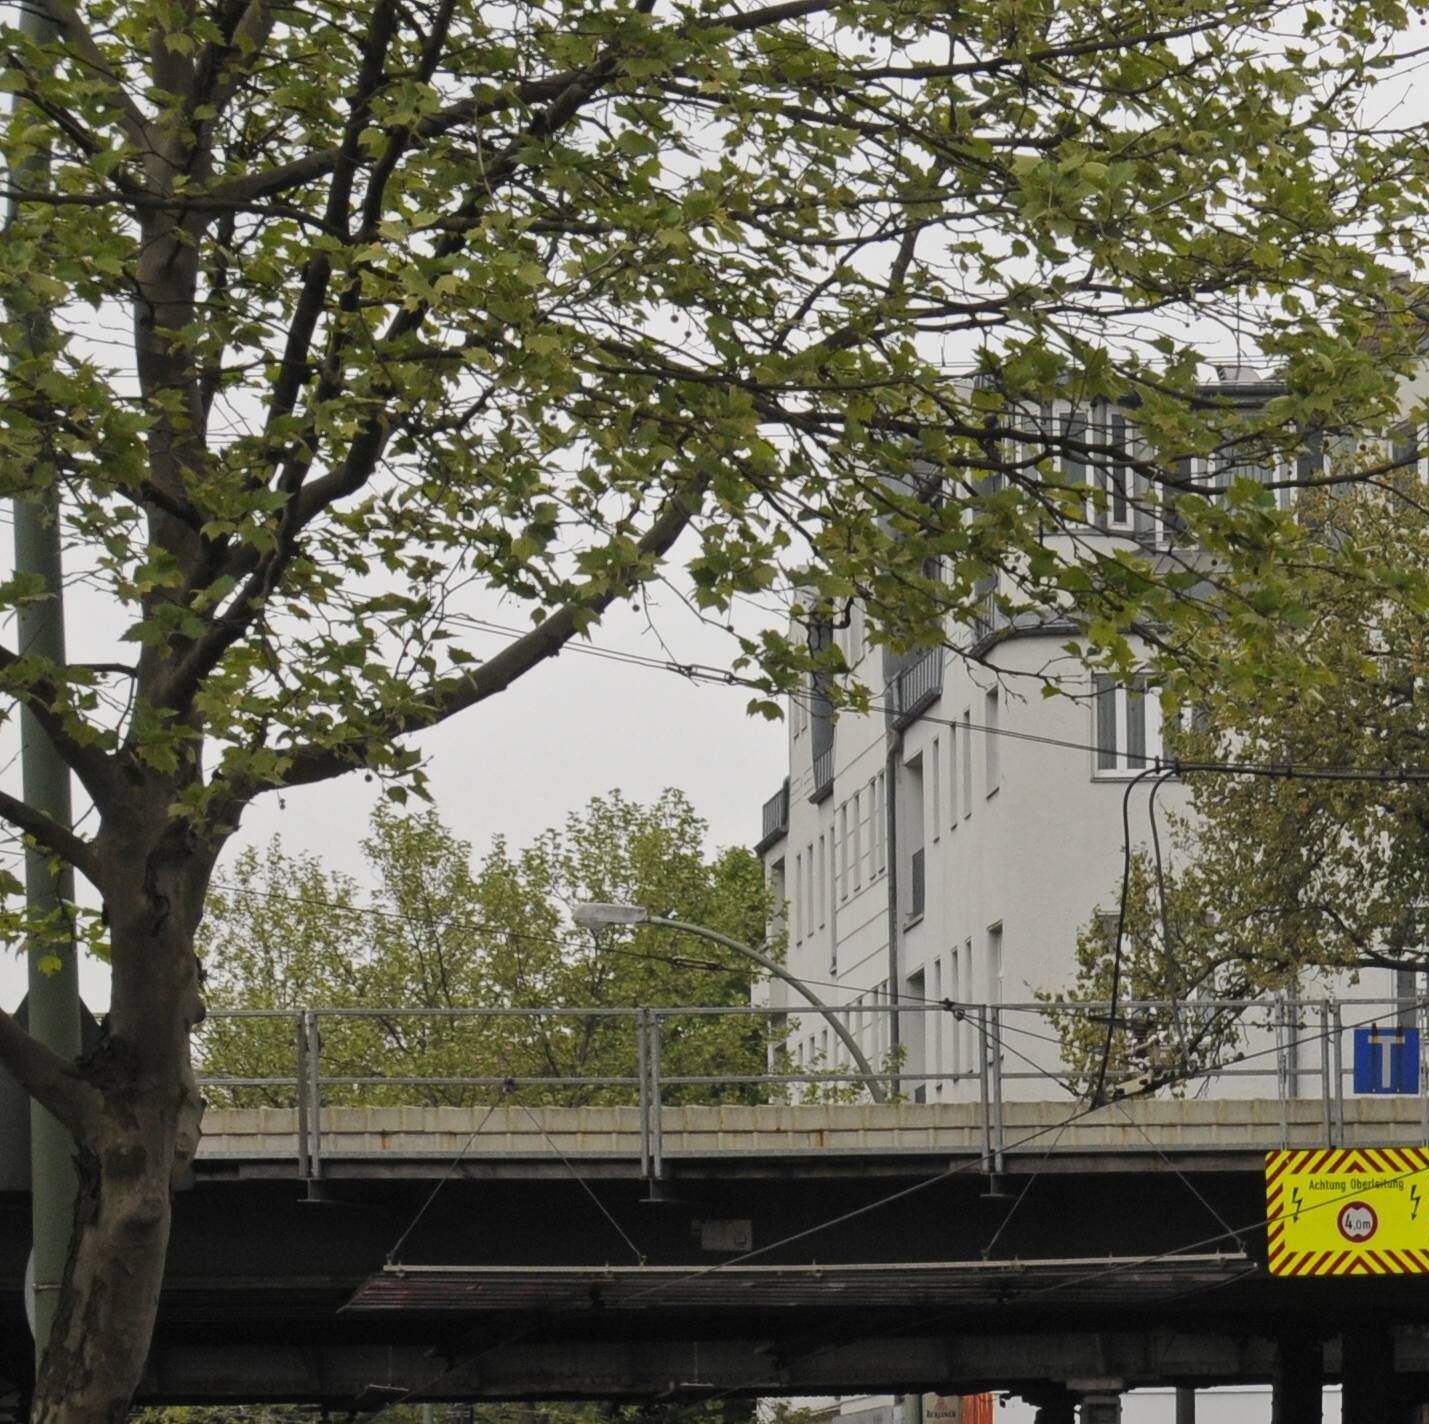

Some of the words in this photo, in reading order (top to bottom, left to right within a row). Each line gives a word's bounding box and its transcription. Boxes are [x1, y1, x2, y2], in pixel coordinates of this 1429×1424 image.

[1368, 1035, 1405, 1088] T
[1309, 1179, 1346, 1192] Achtung
[1350, 1178, 1404, 1191] Oberleitung
